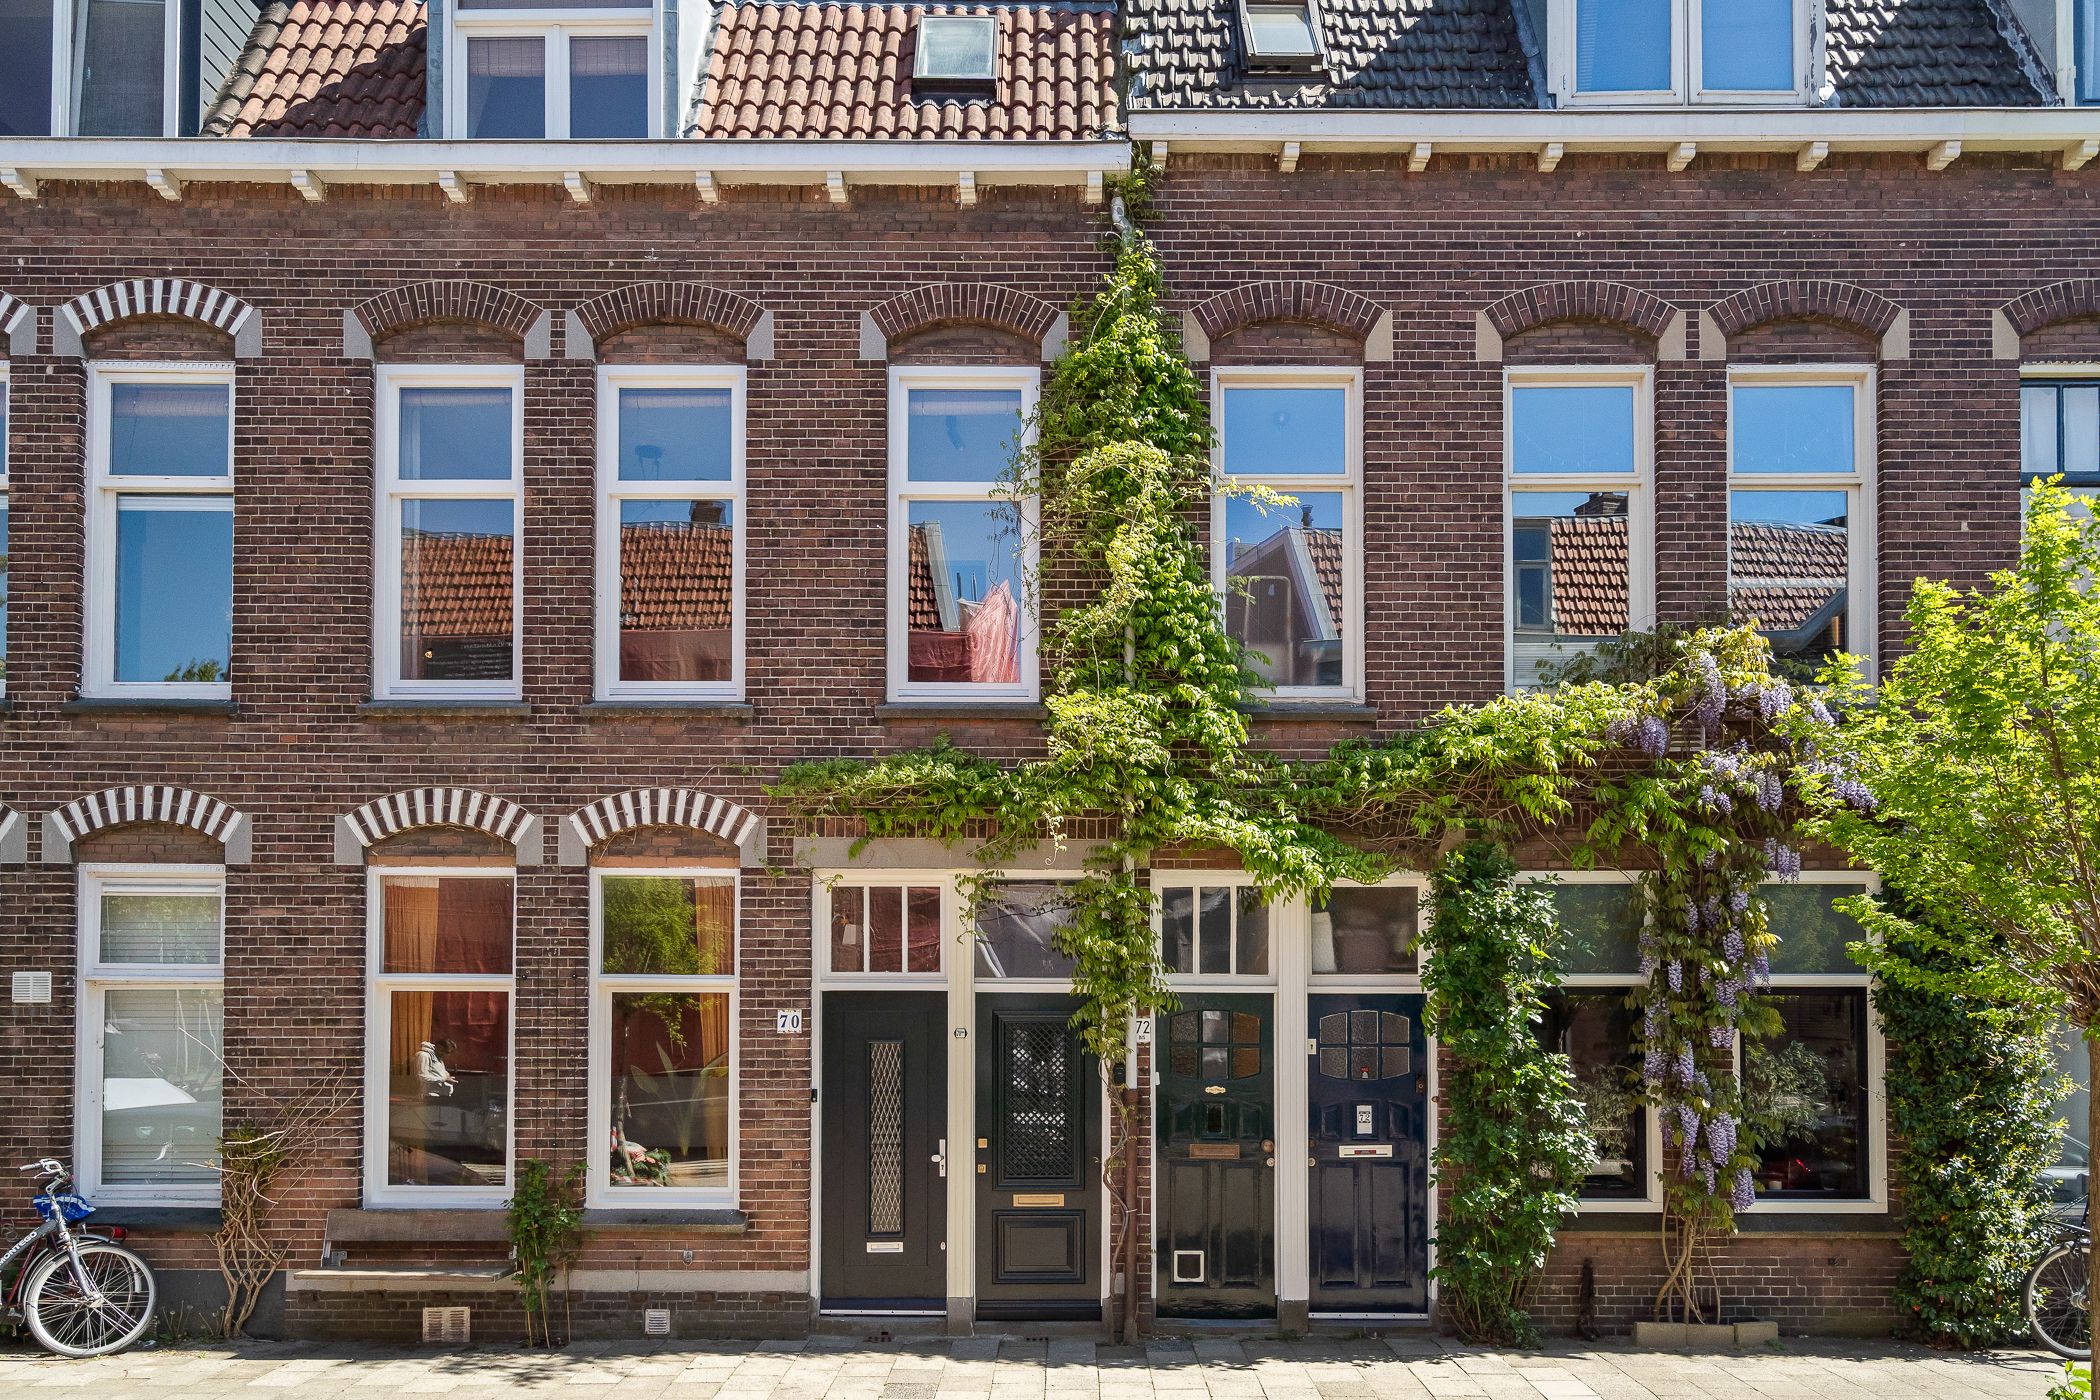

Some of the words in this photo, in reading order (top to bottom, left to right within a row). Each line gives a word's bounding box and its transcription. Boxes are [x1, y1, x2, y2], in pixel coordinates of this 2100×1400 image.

[780, 1015, 800, 1029] 70
[1136, 1021, 1150, 1034] 72
[0, 1231, 38, 1266] MONTEGO
